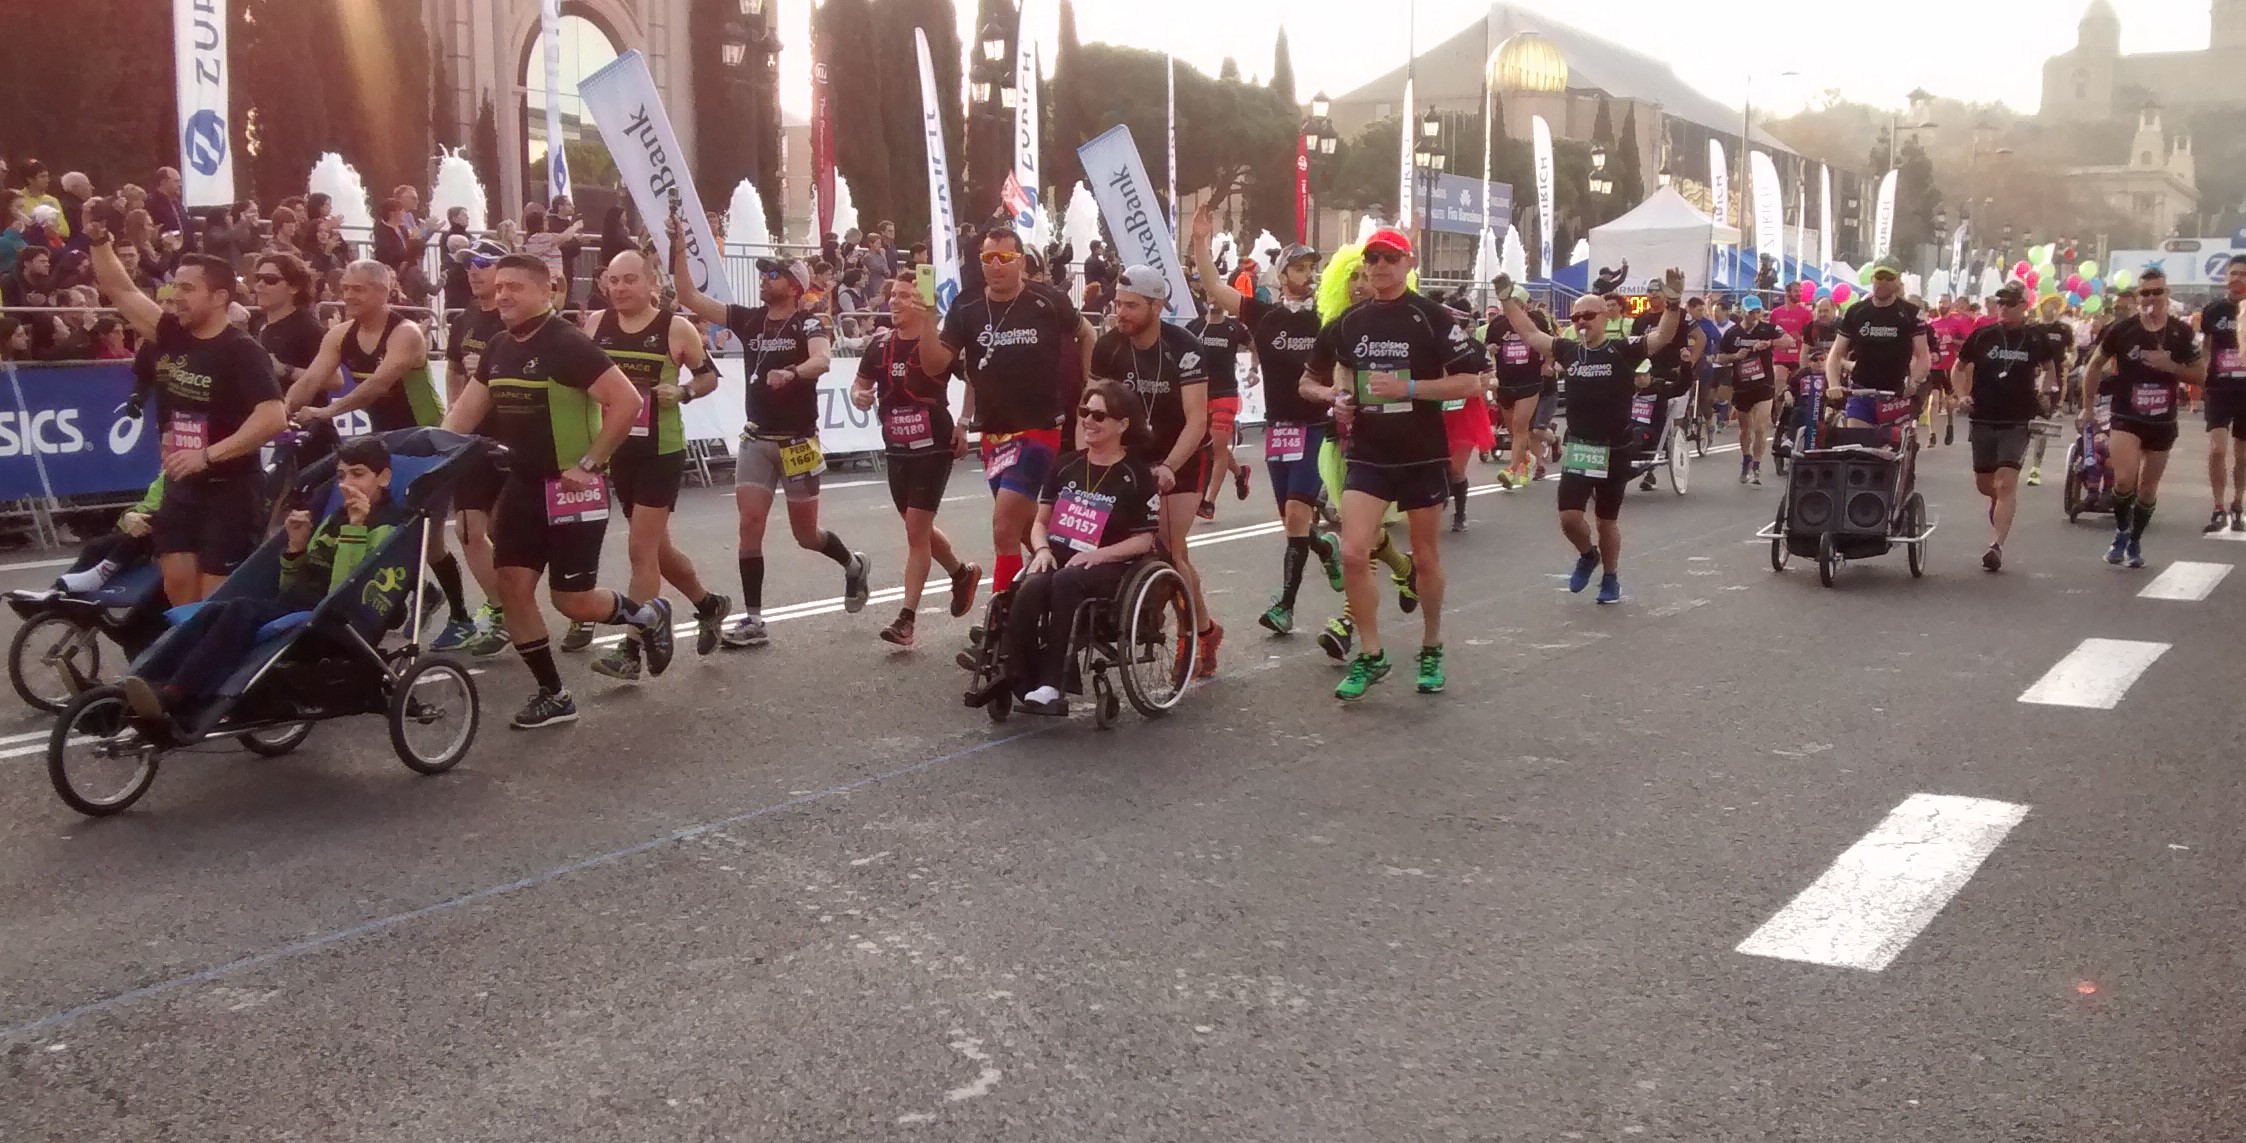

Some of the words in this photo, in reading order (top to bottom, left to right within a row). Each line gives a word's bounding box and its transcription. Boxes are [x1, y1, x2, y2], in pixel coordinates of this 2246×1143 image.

[1614, 285, 1648, 294] ARMIN
[993, 337, 1038, 346] POSITIVO
[1368, 349, 1409, 358] POSITIVO
[891, 423, 925, 436] 20180
[1573, 454, 1605, 464] 17152
[555, 487, 602, 505] 20096
[1067, 503, 1097, 520] PILAR
[1058, 513, 1099, 535] 20157
